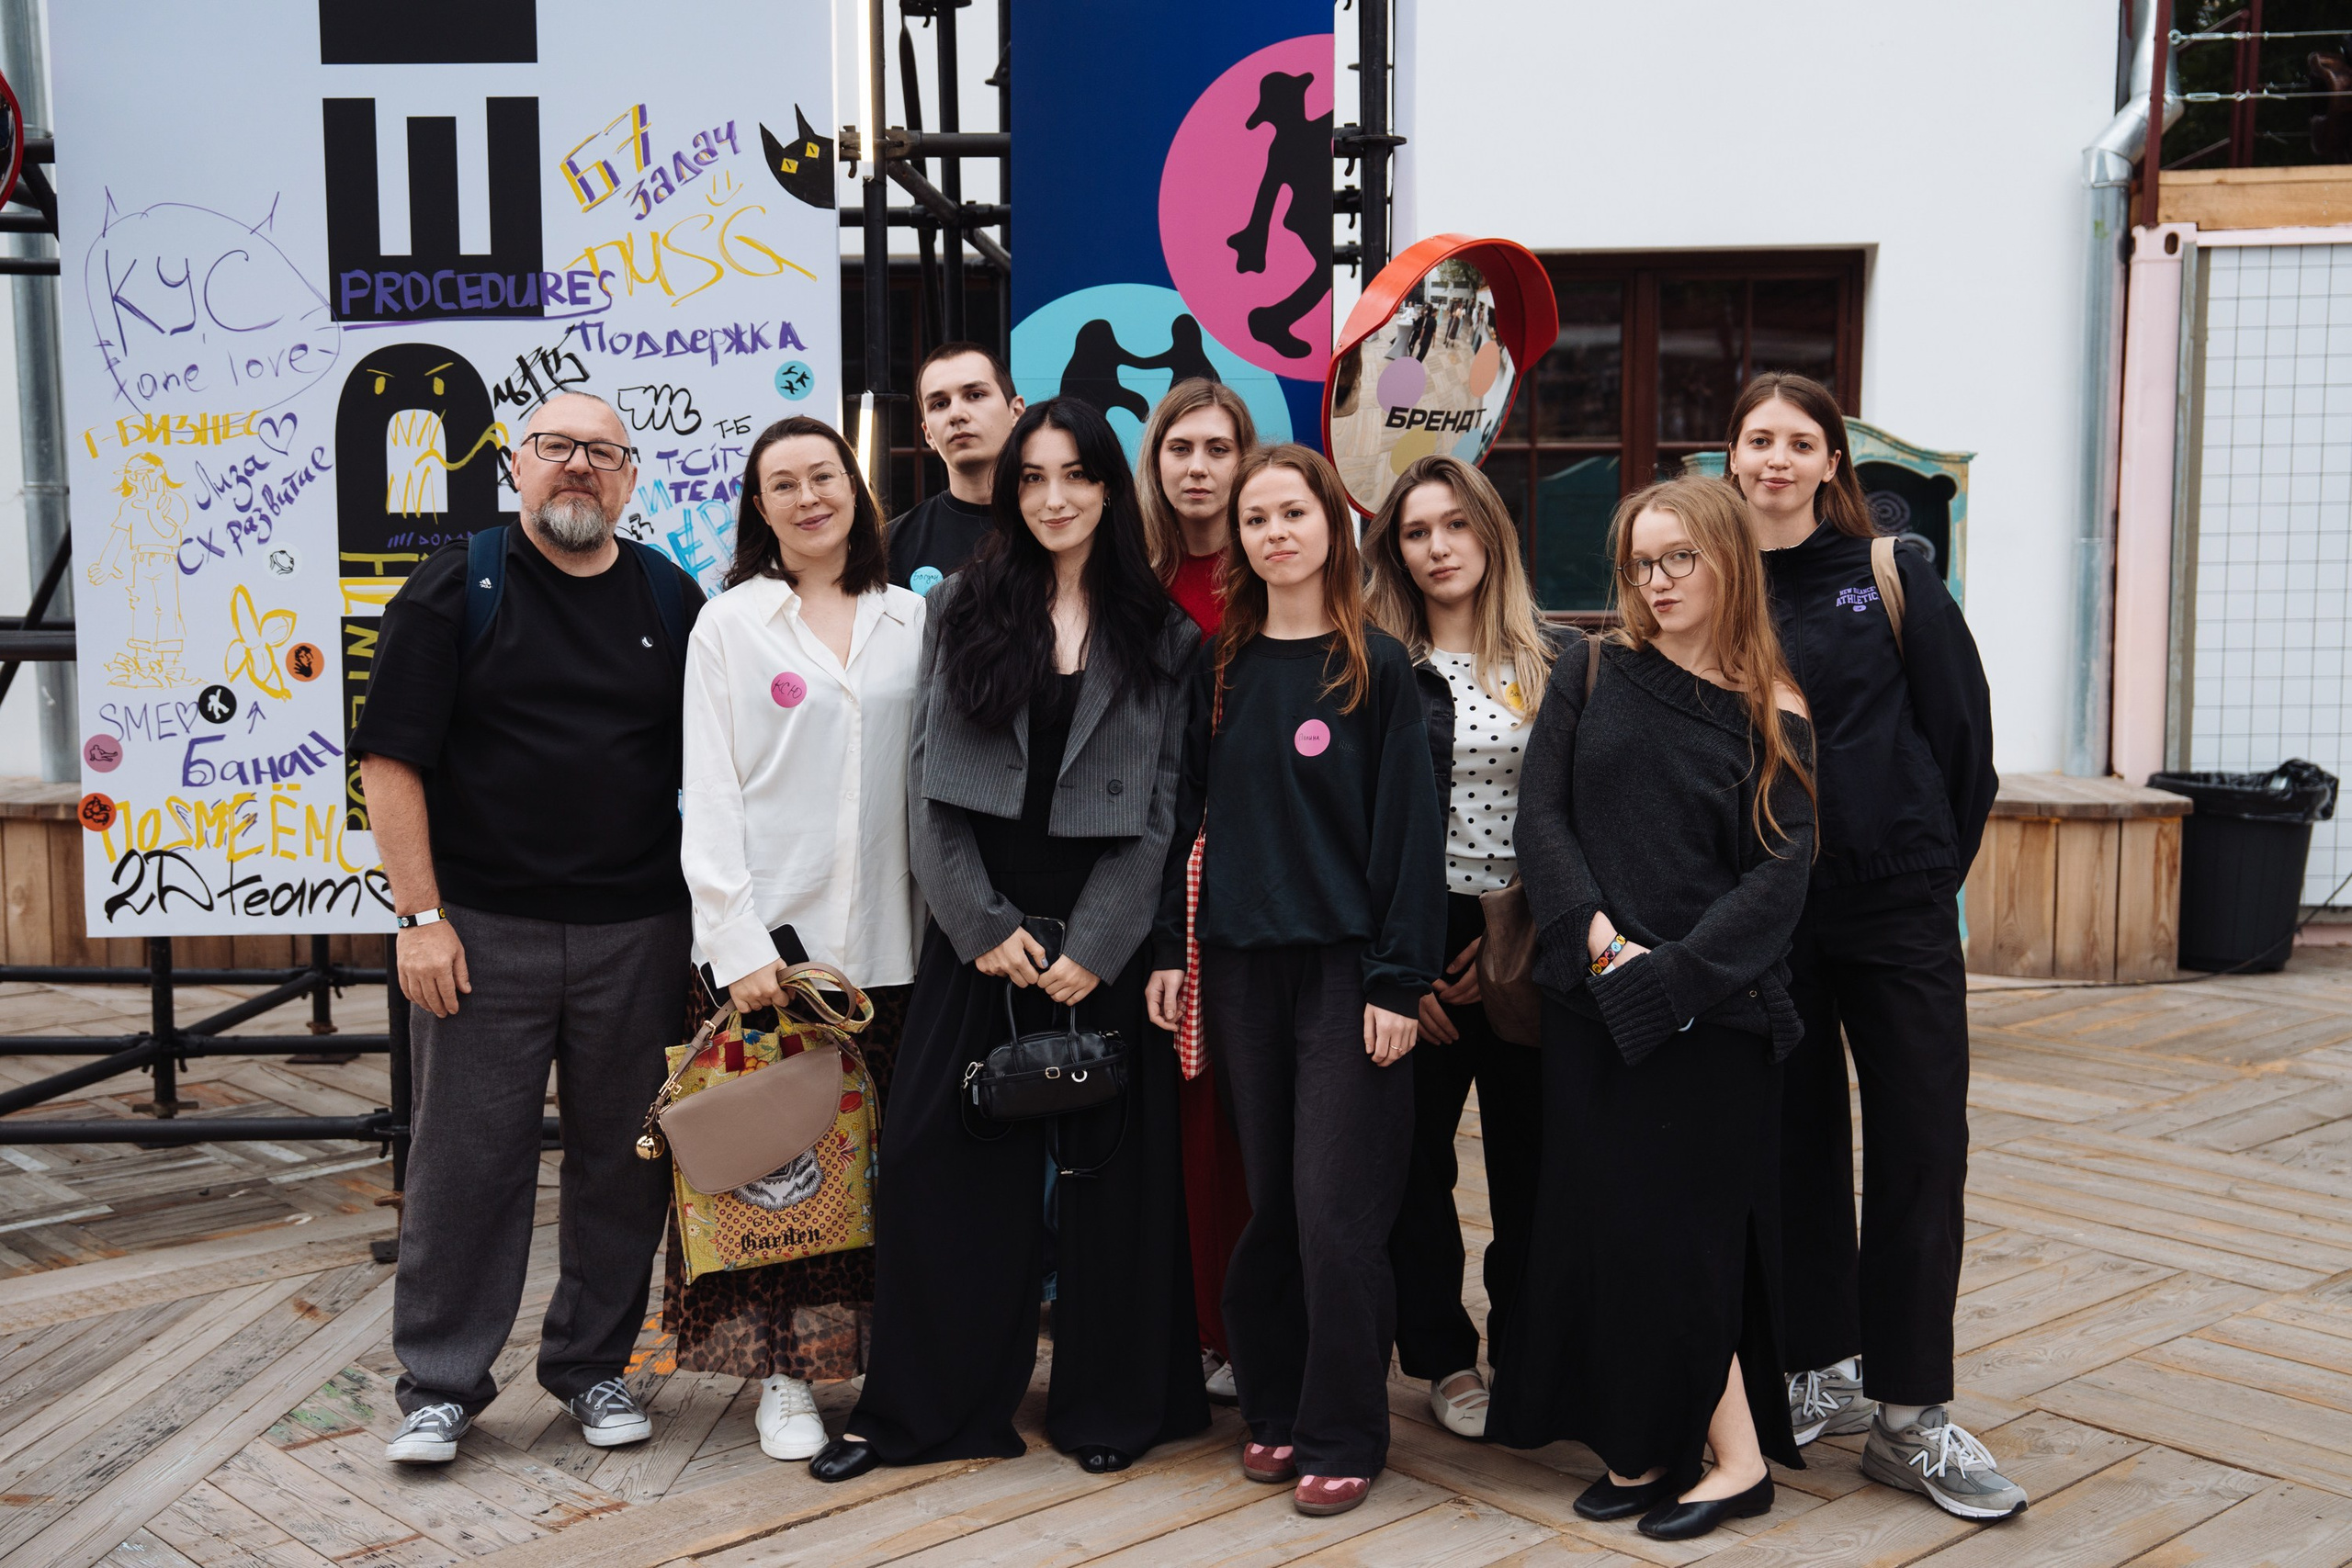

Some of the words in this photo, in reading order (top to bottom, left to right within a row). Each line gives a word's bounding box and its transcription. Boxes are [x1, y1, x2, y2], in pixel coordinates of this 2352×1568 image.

[340, 266, 616, 316] PROCEDURES
[564, 319, 809, 367] Поддержка
[1385, 406, 1487, 434] БРЕНДТ
[194, 455, 272, 511] Лиза
[226, 446, 334, 557] развитие
[1839, 588, 1852, 596] NEW
[182, 730, 345, 787] Банан
[741, 1227, 820, 1254] Garden
